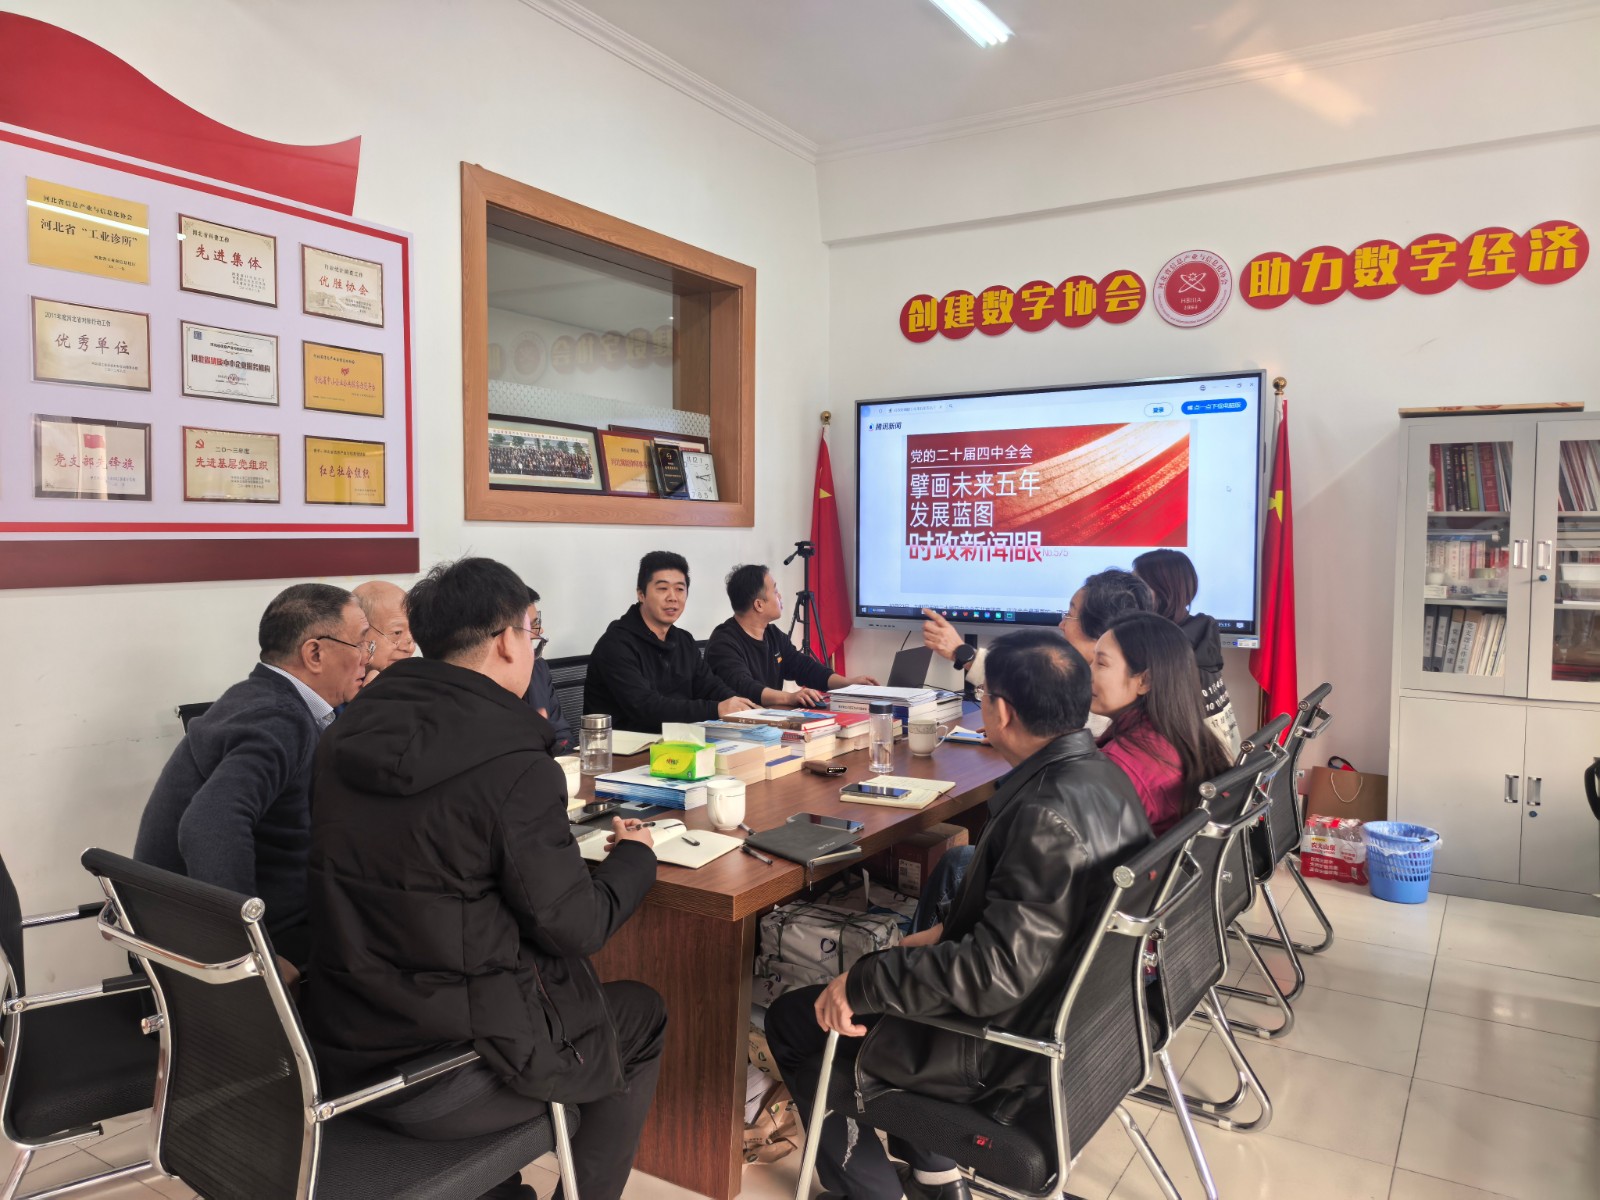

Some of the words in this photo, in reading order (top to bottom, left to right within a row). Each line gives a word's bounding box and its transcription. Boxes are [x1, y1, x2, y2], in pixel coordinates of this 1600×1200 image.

[195, 243, 263, 271] 先进集体
[1248, 225, 1581, 298] 助力数字经济
[319, 275, 369, 296] 优胜协会
[907, 273, 1142, 334] 创建数字协会
[55, 332, 130, 355] 优秀单位
[195, 456, 269, 471] 先进基层党组织
[910, 443, 1033, 464] 党的二十届四中全会
[319, 464, 370, 479] 红色社会组织
[910, 468, 1041, 499] 擘画未来五年
[909, 500, 994, 528] 发展蓝图
[908, 530, 1043, 562] 时政新闻眼
